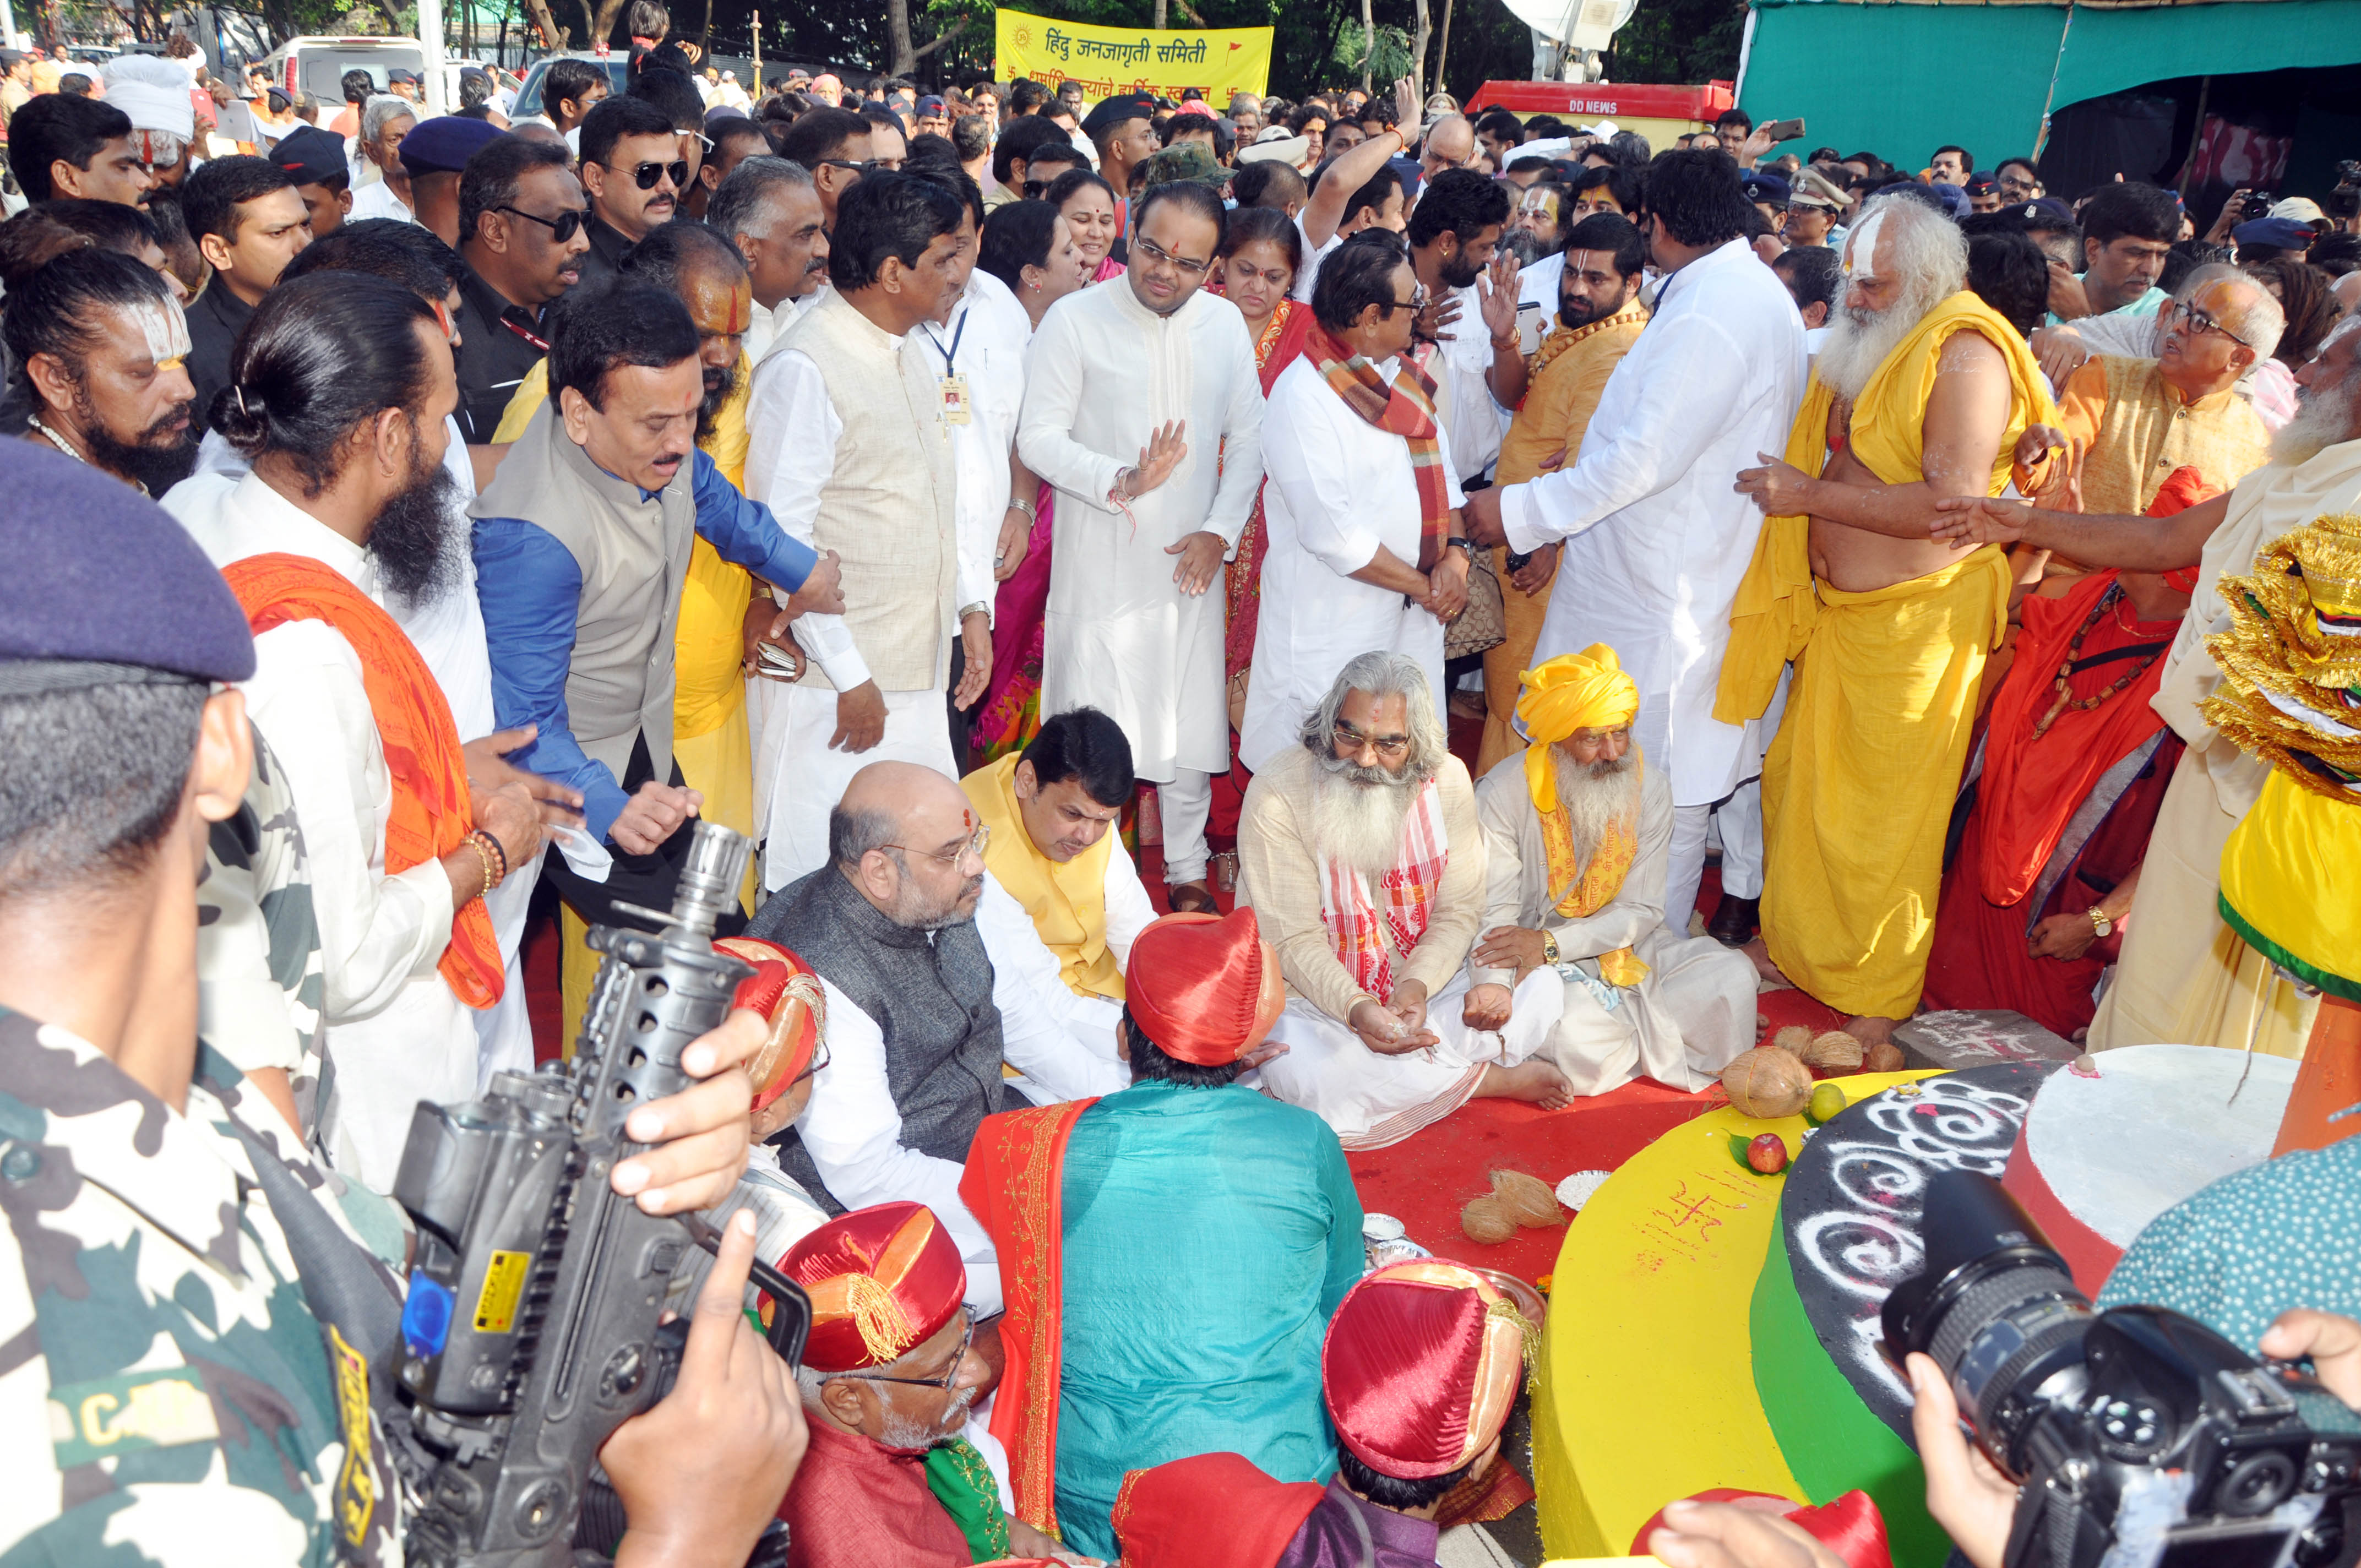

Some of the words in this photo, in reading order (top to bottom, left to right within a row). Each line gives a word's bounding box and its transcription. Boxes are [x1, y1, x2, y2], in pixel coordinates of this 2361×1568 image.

[1046, 28, 1071, 61] हिंदु
[1077, 37, 1151, 68] जनजागृती
[1156, 38, 1207, 63] समिती
[1569, 100, 1584, 112] DD
[1586, 101, 1617, 114] NEWS
